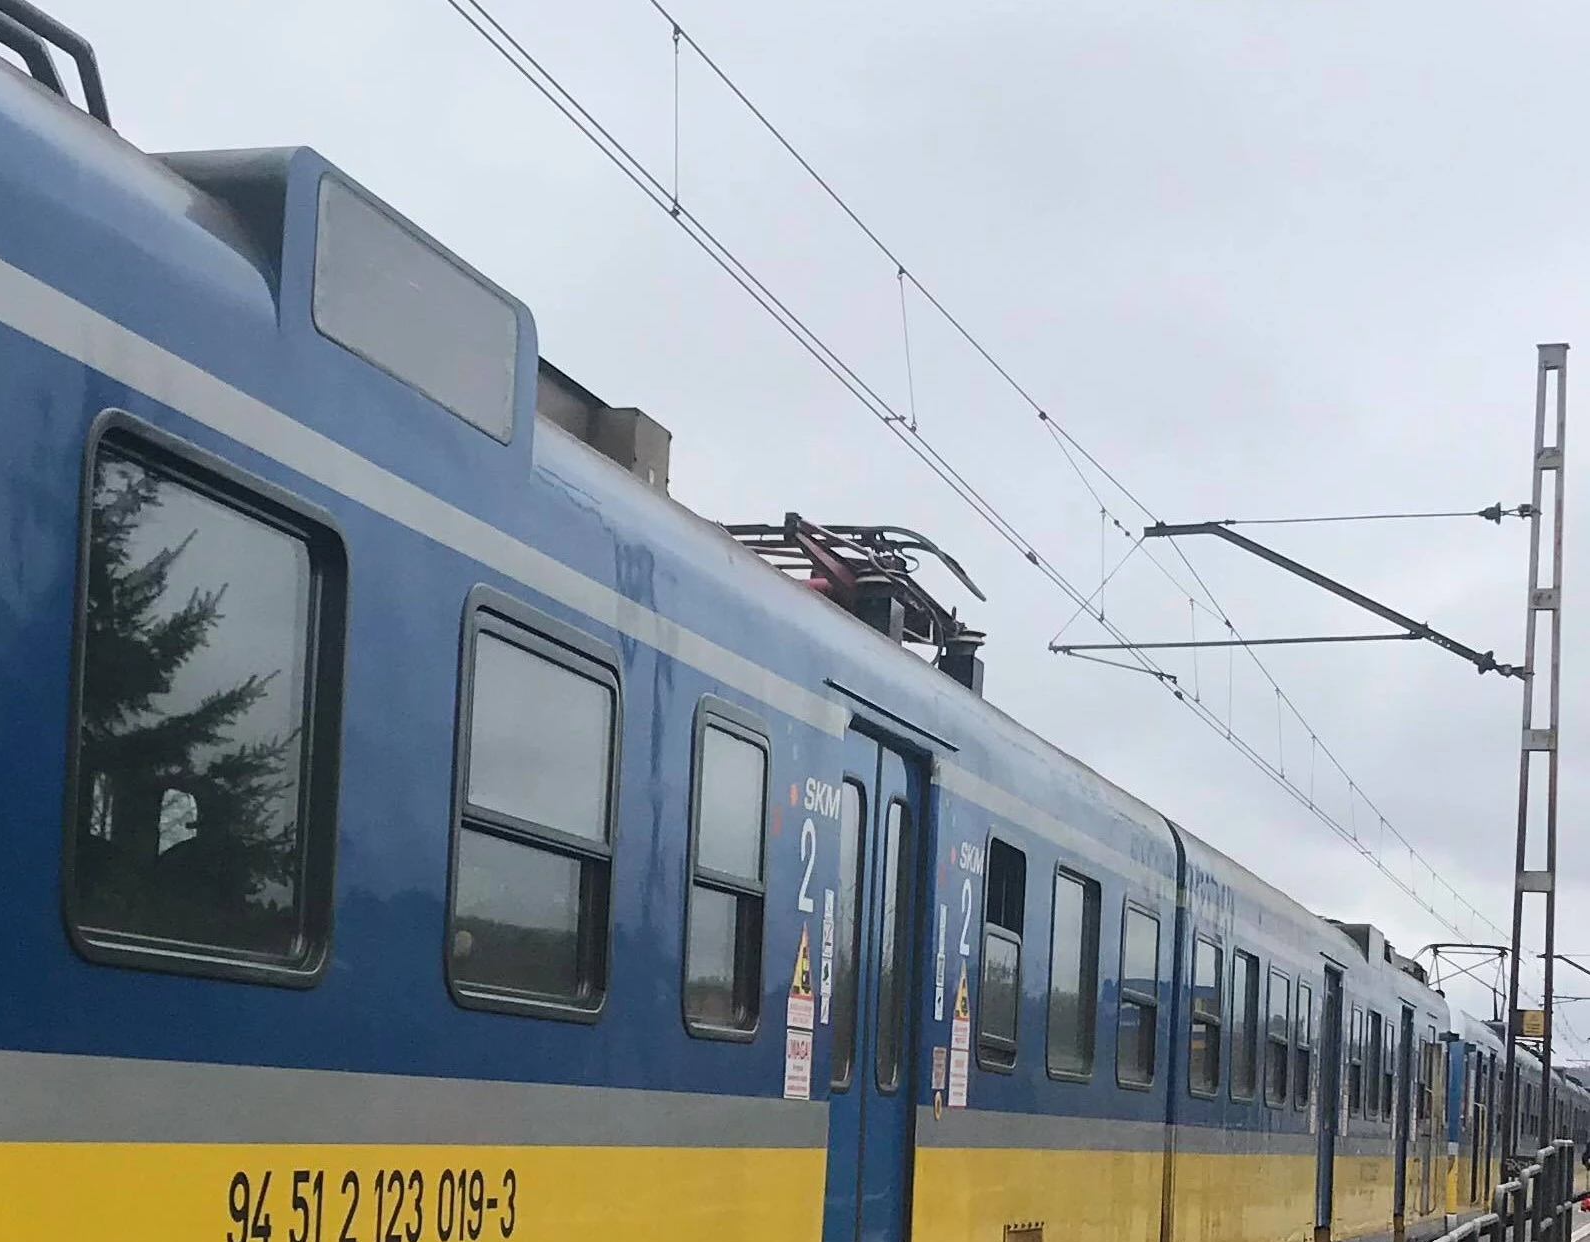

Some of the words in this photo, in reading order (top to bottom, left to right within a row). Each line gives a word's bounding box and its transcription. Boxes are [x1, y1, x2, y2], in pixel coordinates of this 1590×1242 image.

[804, 778, 841, 820] SKM
[798, 818, 816, 912] 2
[960, 842, 985, 877] SKM
[959, 878, 972, 956] 2
[437, 1168, 517, 1242] 019-3
